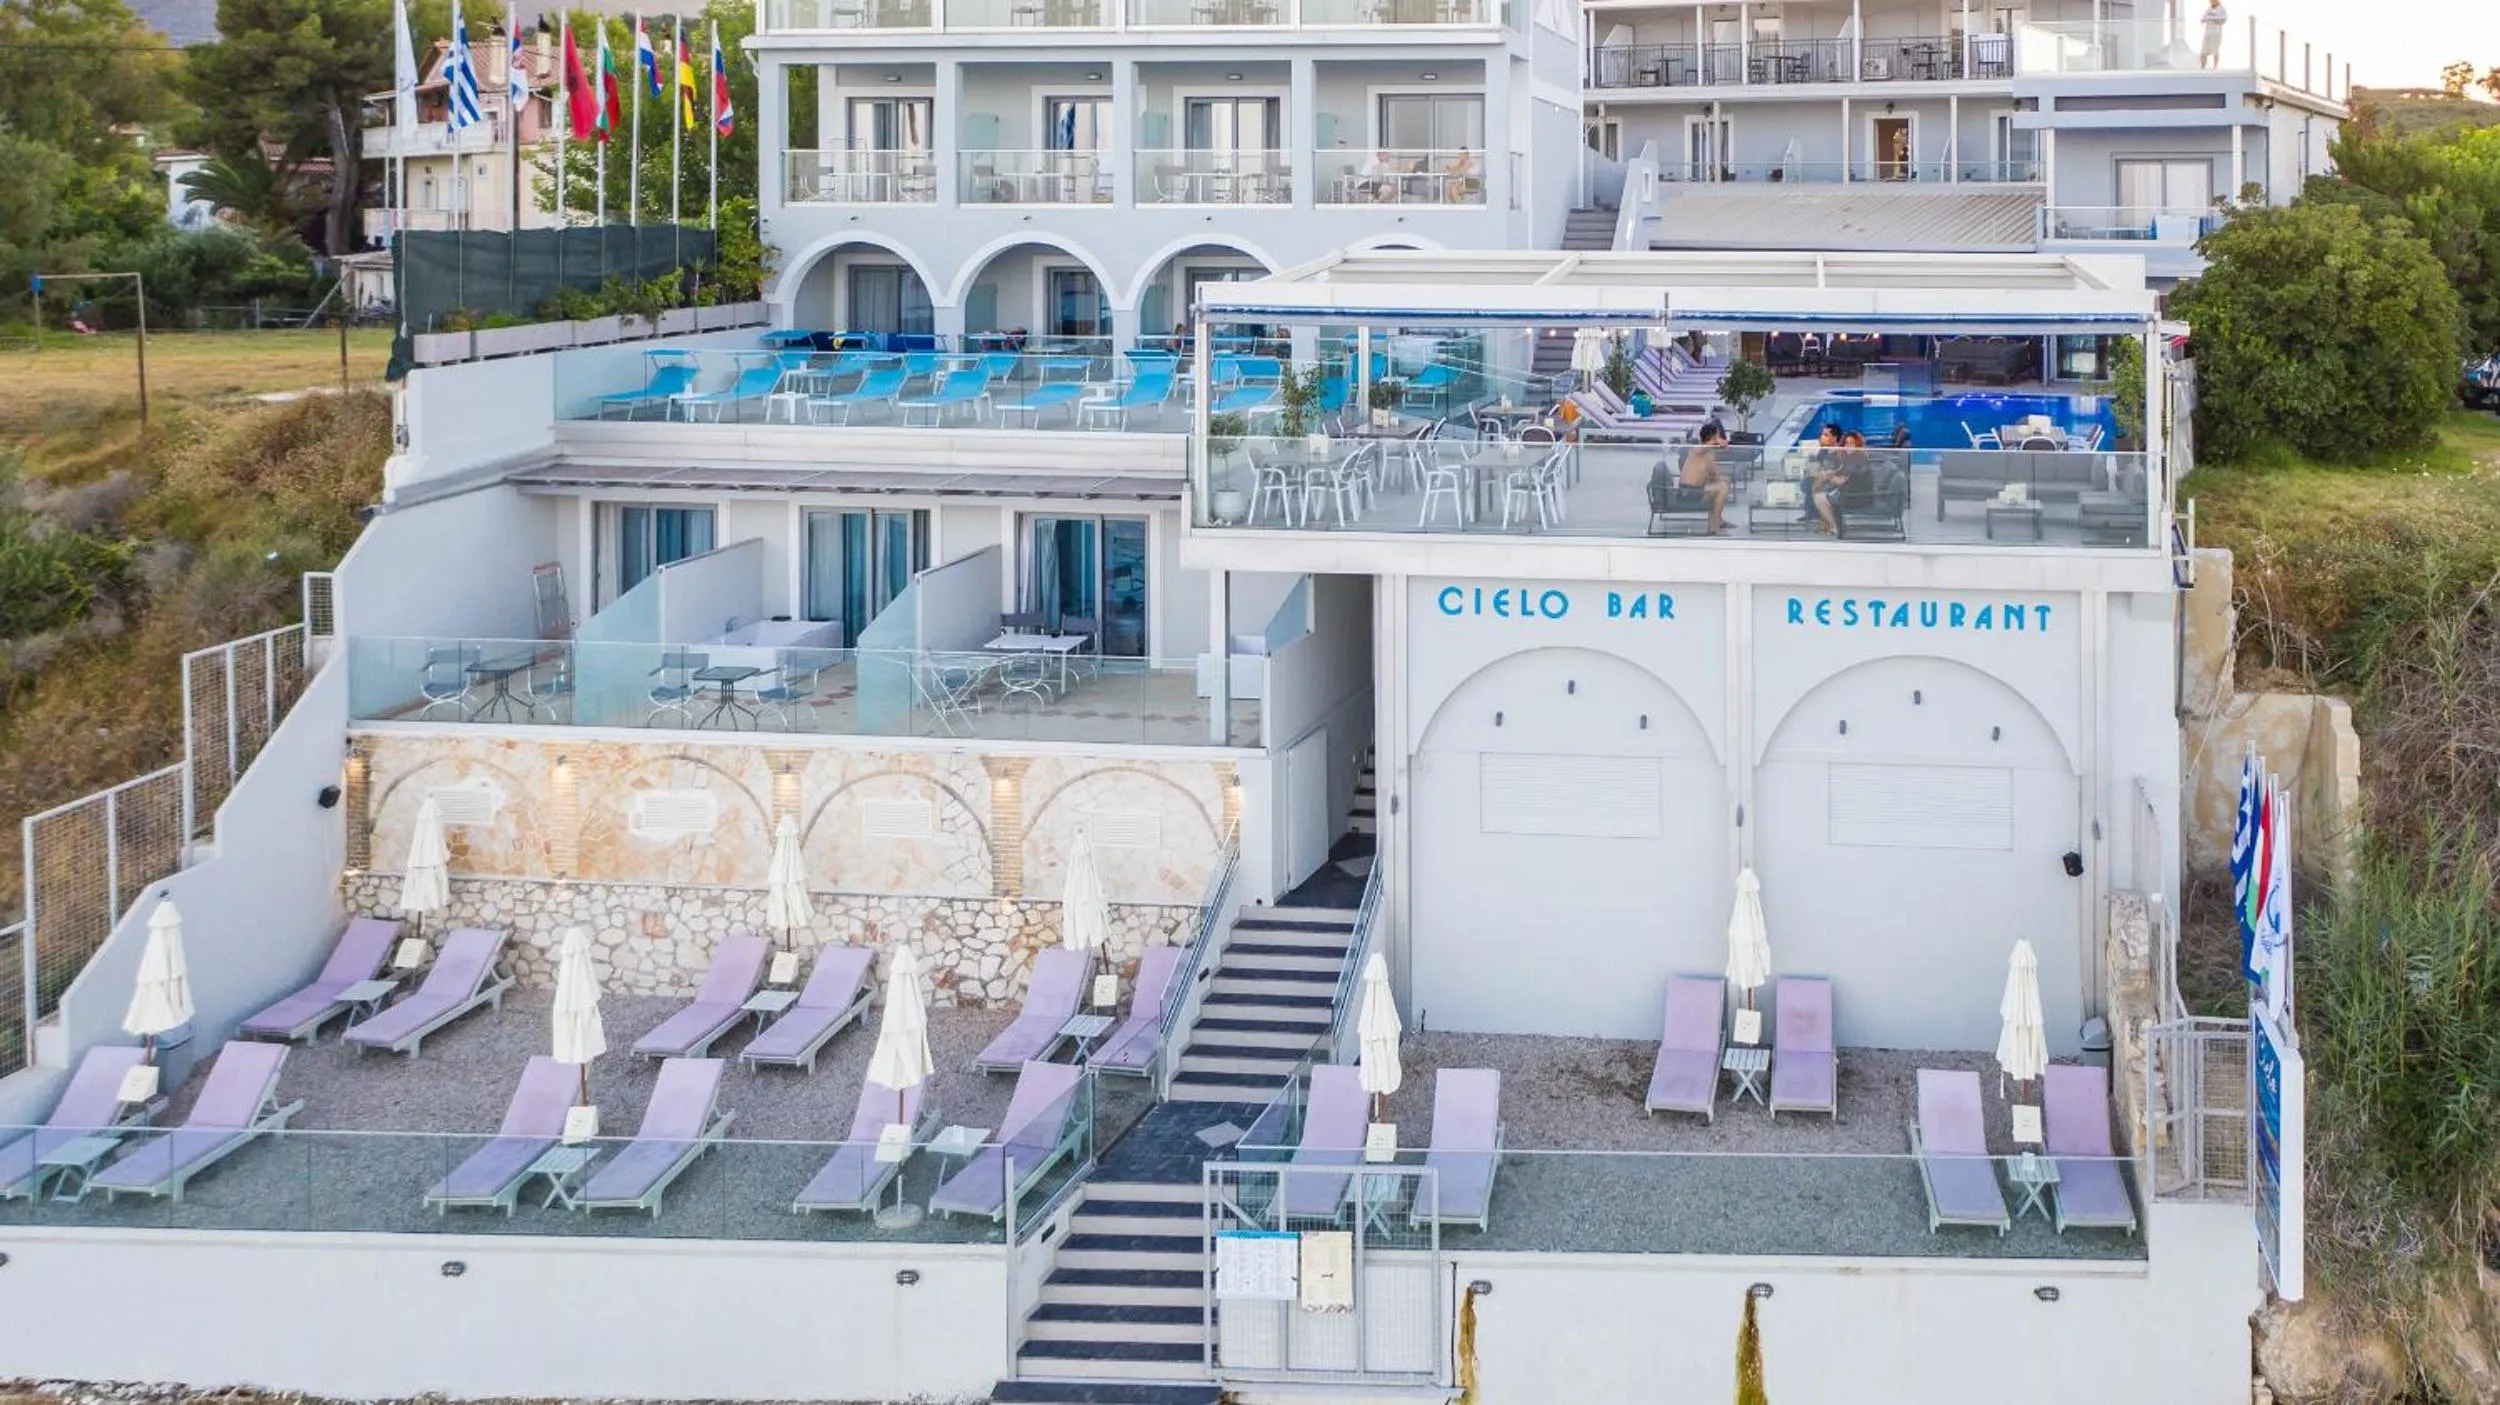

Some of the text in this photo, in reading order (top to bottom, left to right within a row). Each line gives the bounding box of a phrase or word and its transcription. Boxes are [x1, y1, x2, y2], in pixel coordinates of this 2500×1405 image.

[1437, 585, 1675, 620] CIELO BAR
[1786, 597, 2052, 633] RESTAURANT
